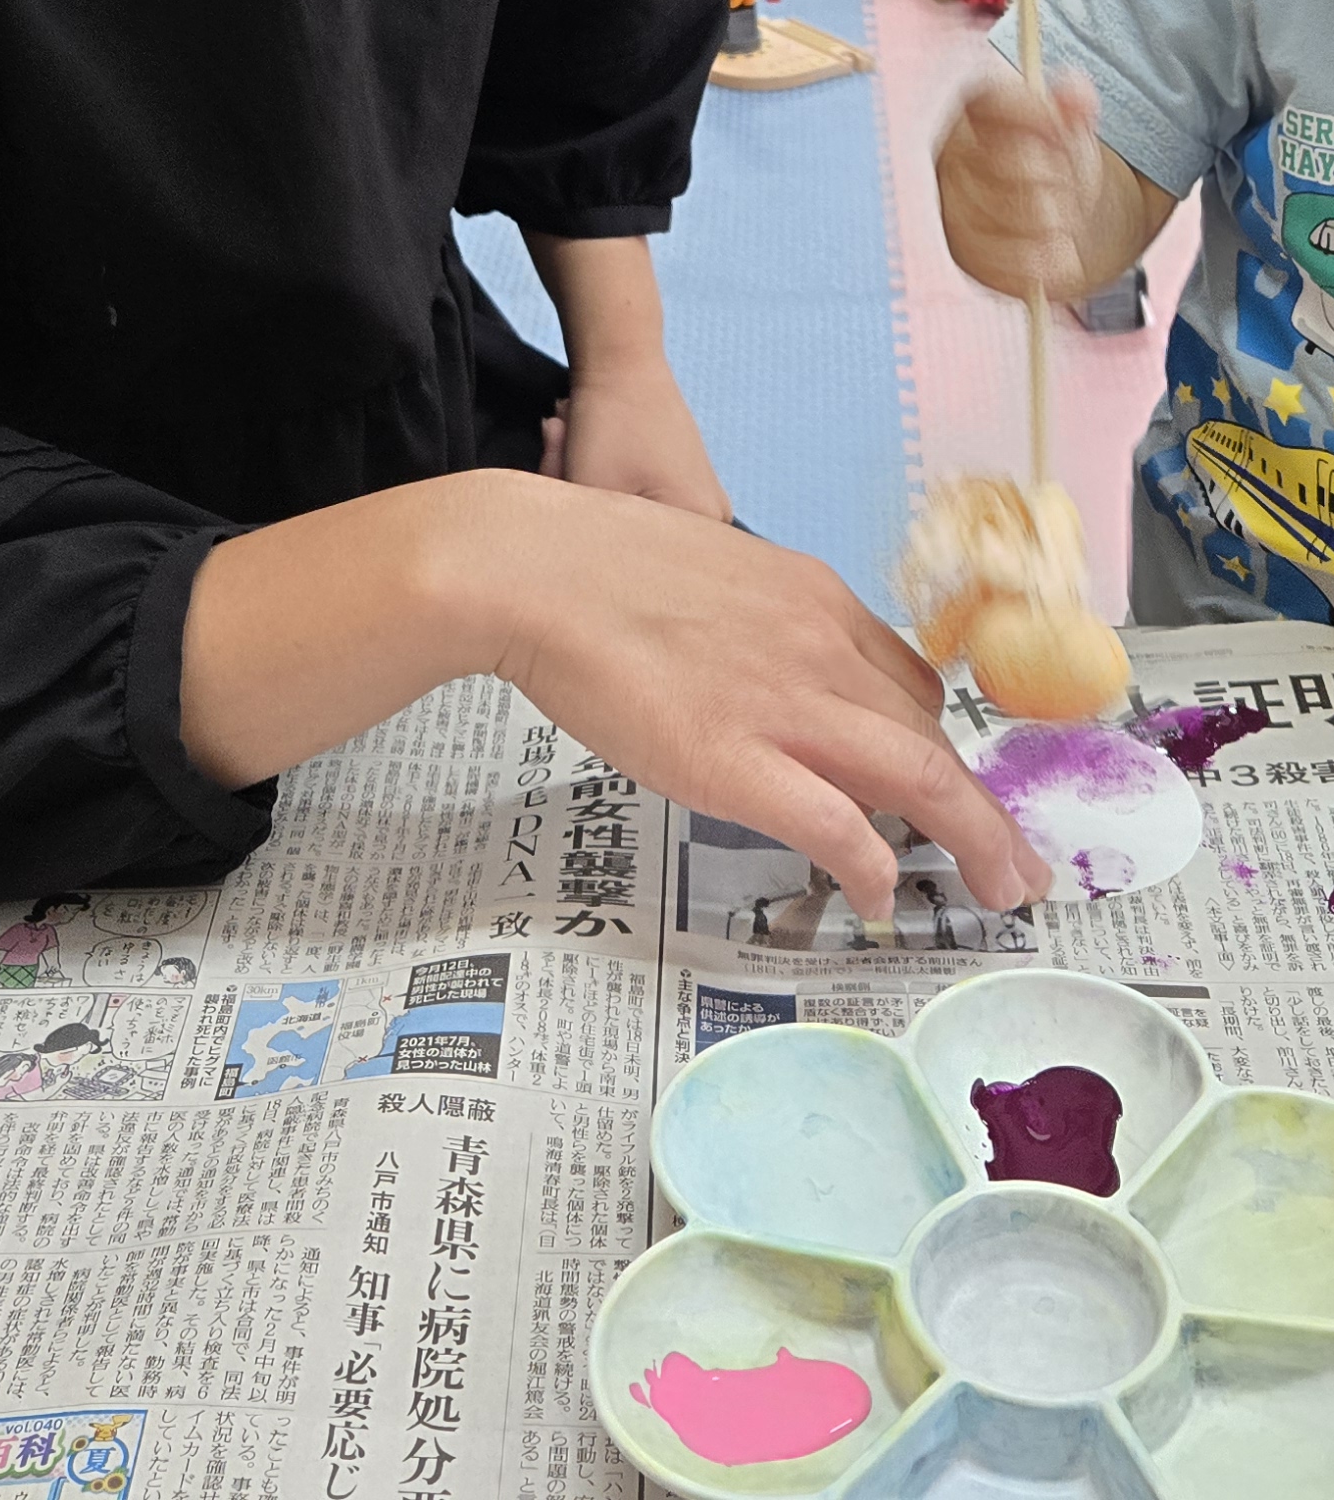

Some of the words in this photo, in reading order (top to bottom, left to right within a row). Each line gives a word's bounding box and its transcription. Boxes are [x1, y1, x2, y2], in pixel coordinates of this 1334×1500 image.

[675, 979, 693, 1063] 主な争点と判決
[396, 1059, 492, 1074] 見つかった山林
[378, 1093, 496, 1123] 殺人隠蔽
[363, 1151, 399, 1254] 八戸市通知
[6, 1418, 63, 1436] vol.040
[79, 1448, 116, 1475] 夏
